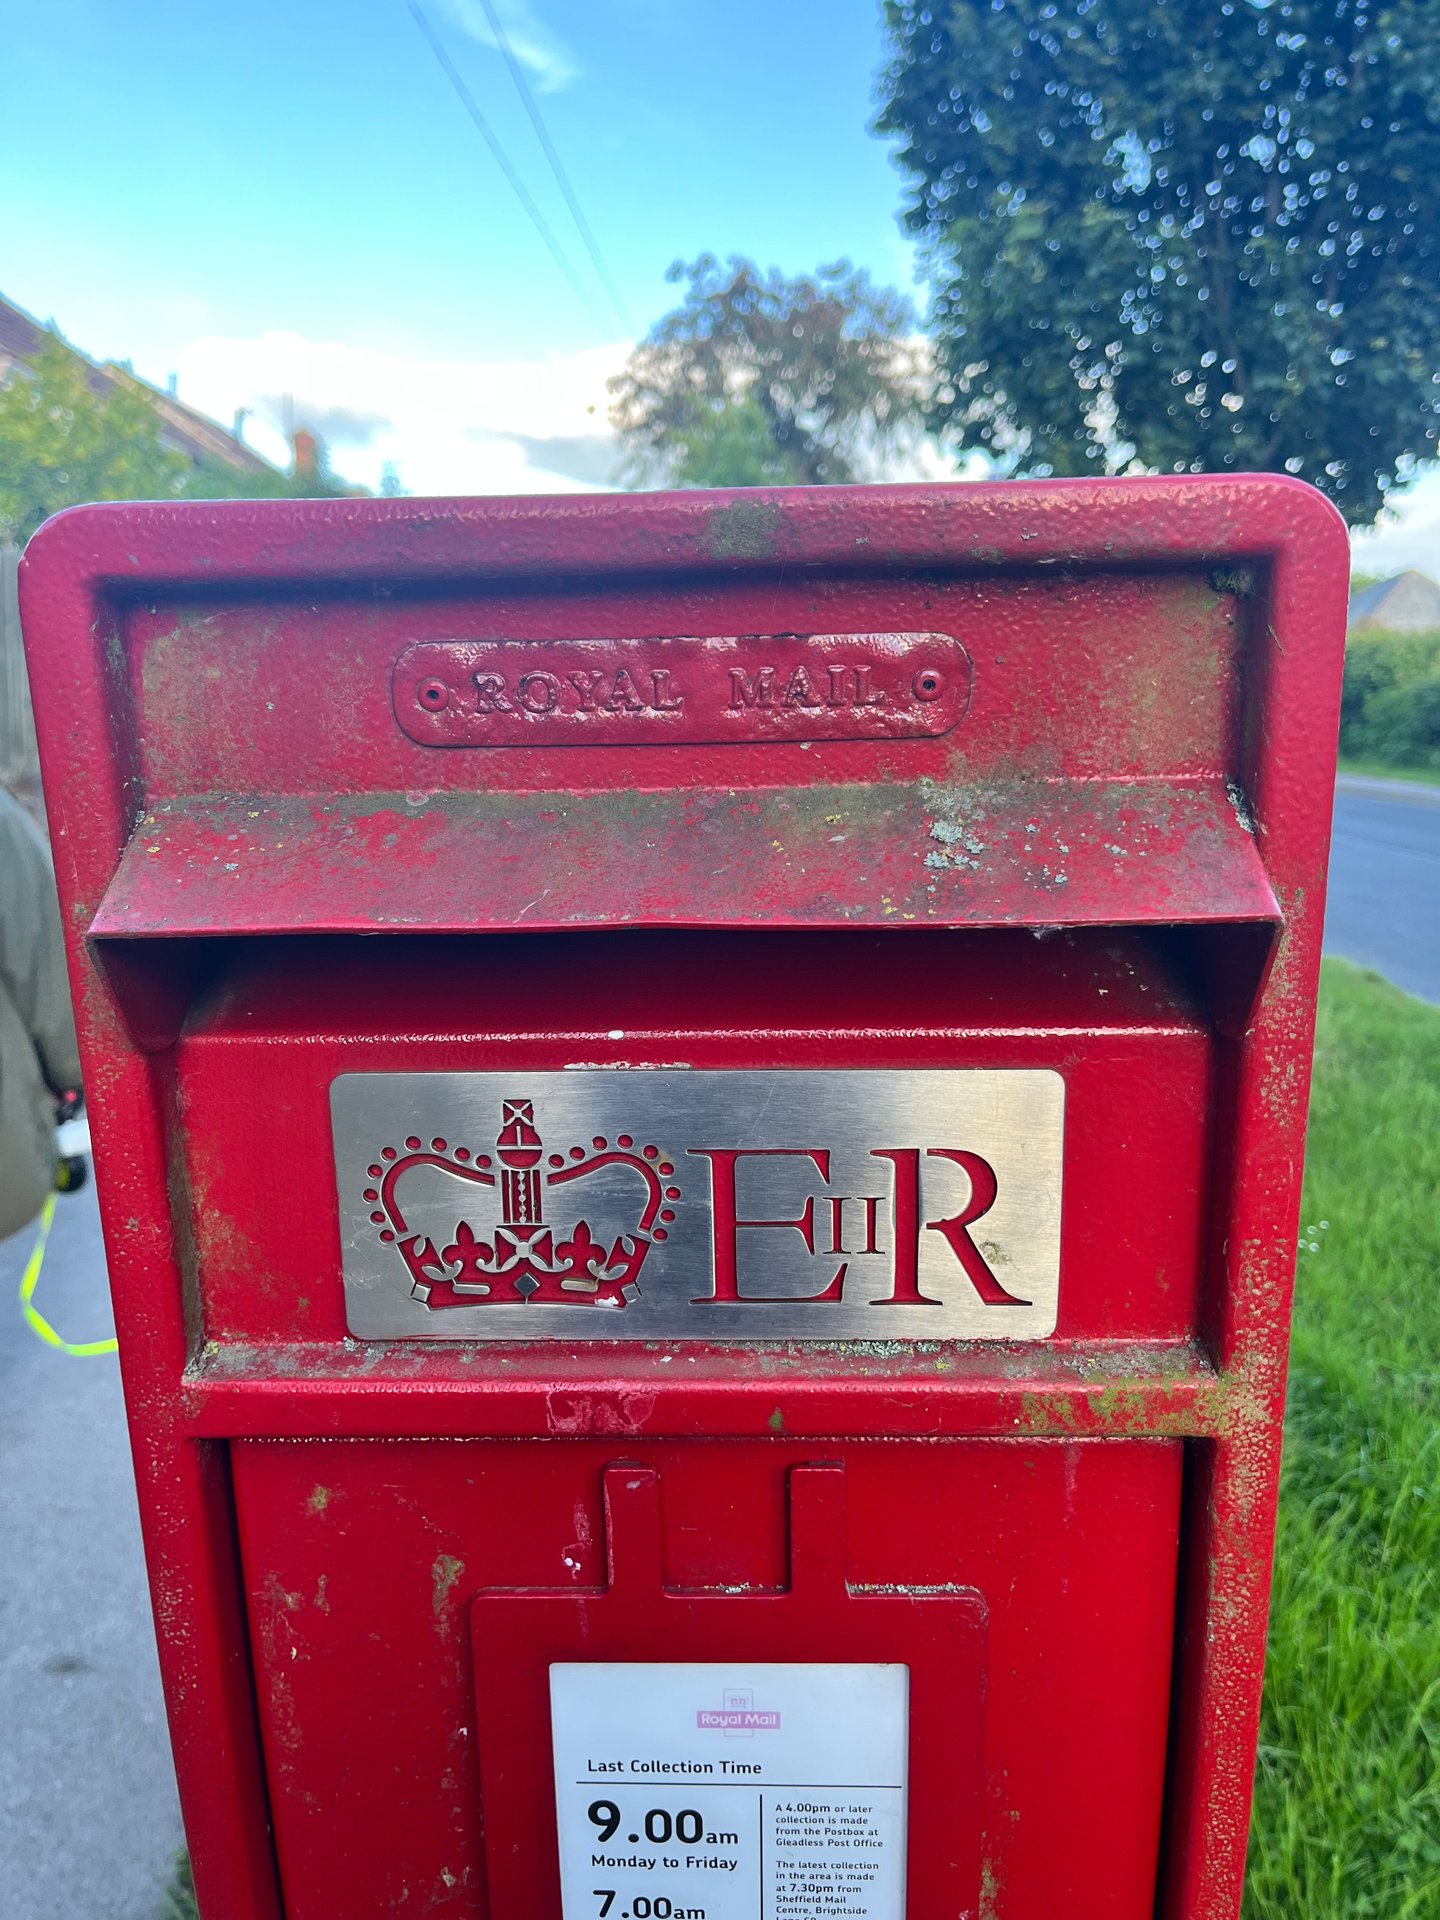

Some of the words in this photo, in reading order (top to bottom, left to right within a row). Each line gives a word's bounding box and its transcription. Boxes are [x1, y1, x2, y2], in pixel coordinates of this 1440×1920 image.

[472, 668, 684, 714] ROYAL
[727, 664, 887, 710] MAIL
[701, 1713, 741, 1727] Royal
[745, 1714, 776, 1726] Mail
[587, 1759, 624, 1773] Last
[630, 1760, 713, 1774] Collection
[718, 1761, 762, 1774] Time
[775, 1804, 782, 1812] A
[786, 1803, 831, 1814] 4.00pm
[849, 1805, 873, 1813] later
[587, 1800, 739, 1844] 9.00am
[775, 1816, 825, 1824] collection
[828, 1816, 837, 1825] is
[840, 1817, 869, 1825] made
[775, 1827, 800, 1835] from
[804, 1828, 821, 1836] the
[824, 1828, 865, 1836] Postbox
[868, 1829, 879, 1837] at
[775, 1838, 824, 1847] Gleadless
[827, 1839, 850, 1847] Post
[853, 1839, 883, 1848] Office
[591, 1855, 656, 1870] Monday
[663, 1857, 679, 1868] to
[686, 1856, 738, 1871] Friday
[775, 1860, 795, 1869] The
[798, 1861, 827, 1869] latest
[830, 1861, 879, 1870] collection
[775, 1871, 785, 1879] in
[789, 1871, 806, 1880] the
[834, 1872, 844, 1880] is
[846, 1873, 875, 1881] made
[775, 1884, 786, 1892] at
[790, 1883, 834, 1895] 7.30pm
[837, 1885, 862, 1893] from
[592, 1889, 706, 1920] 7.00am
[775, 1895, 821, 1903] Sheffield
[824, 1896, 846, 1904] Mail
[775, 1906, 812, 1915] Centre,
[815, 1906, 868, 1915] Brightside
